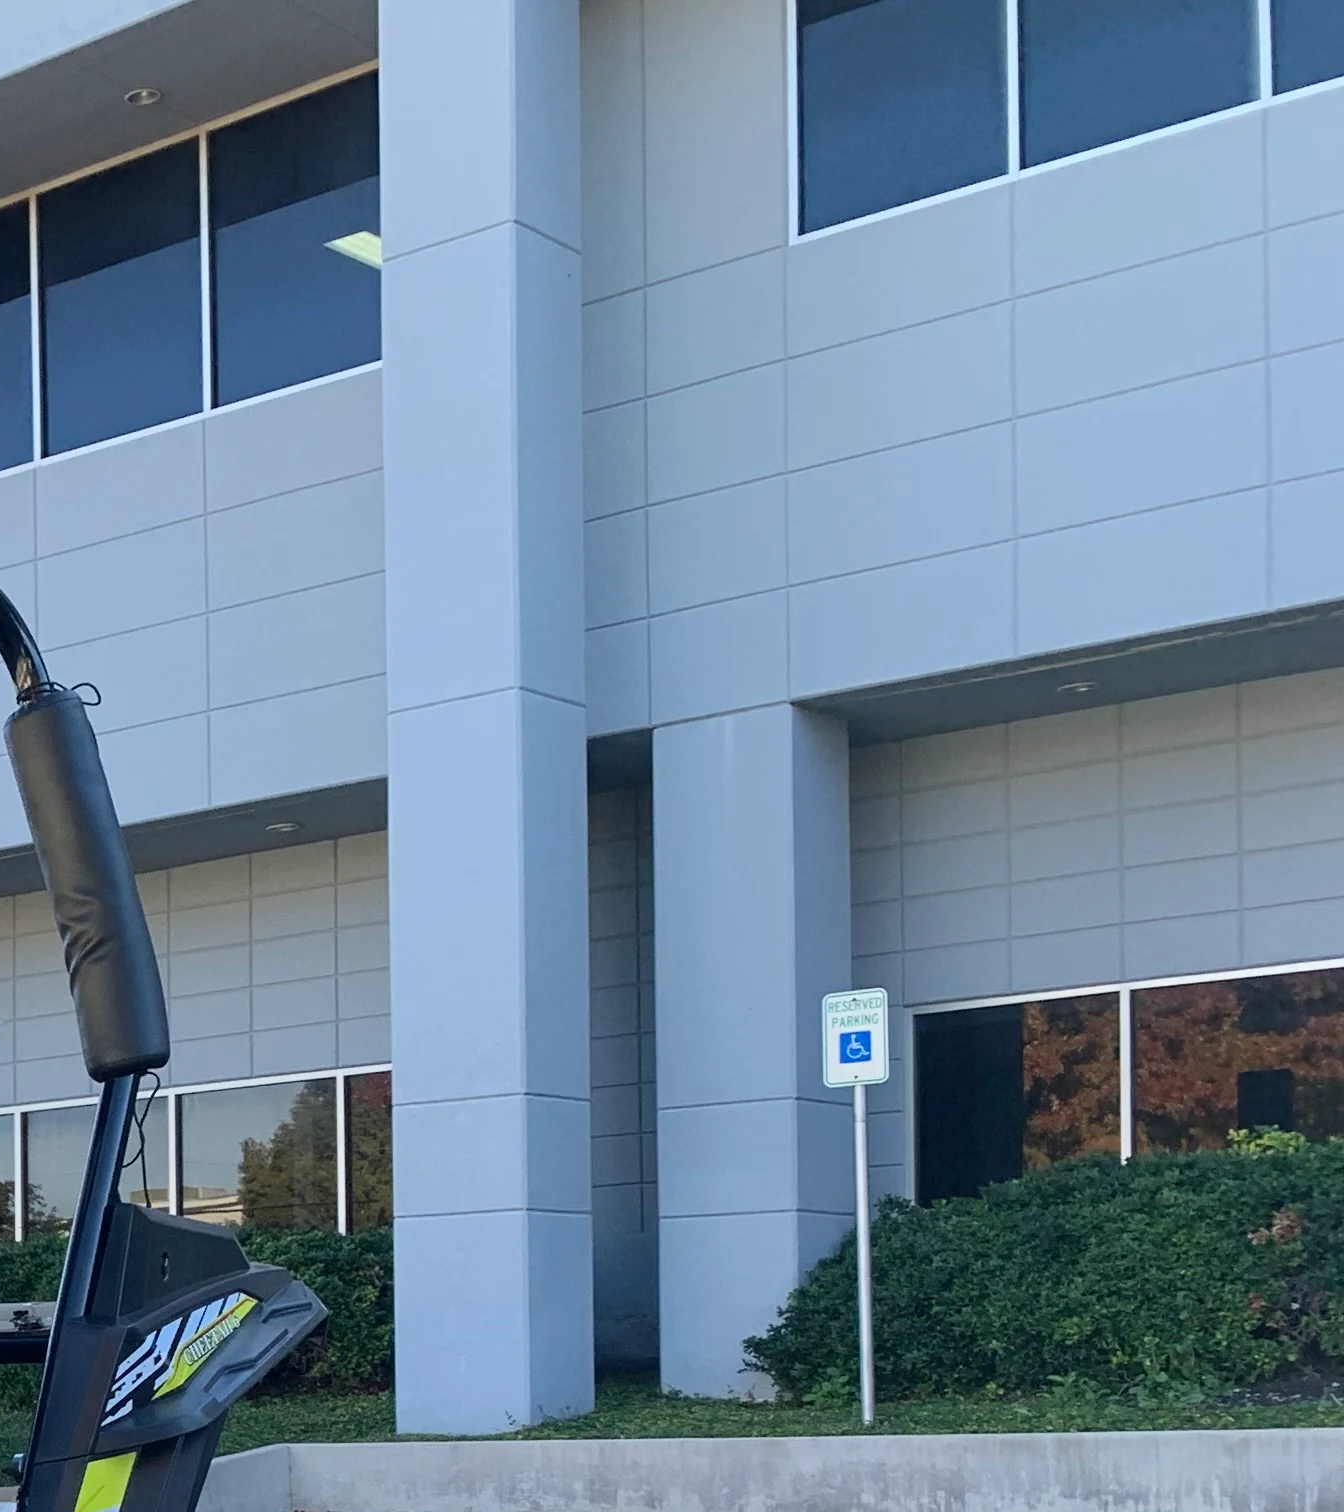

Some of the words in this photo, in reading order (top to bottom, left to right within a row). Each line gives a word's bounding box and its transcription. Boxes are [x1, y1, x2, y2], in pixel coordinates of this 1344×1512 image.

[828, 997, 882, 1013] RESERVED
[832, 1012, 880, 1028] PARKING
[183, 1317, 234, 1366] CHEETAH
